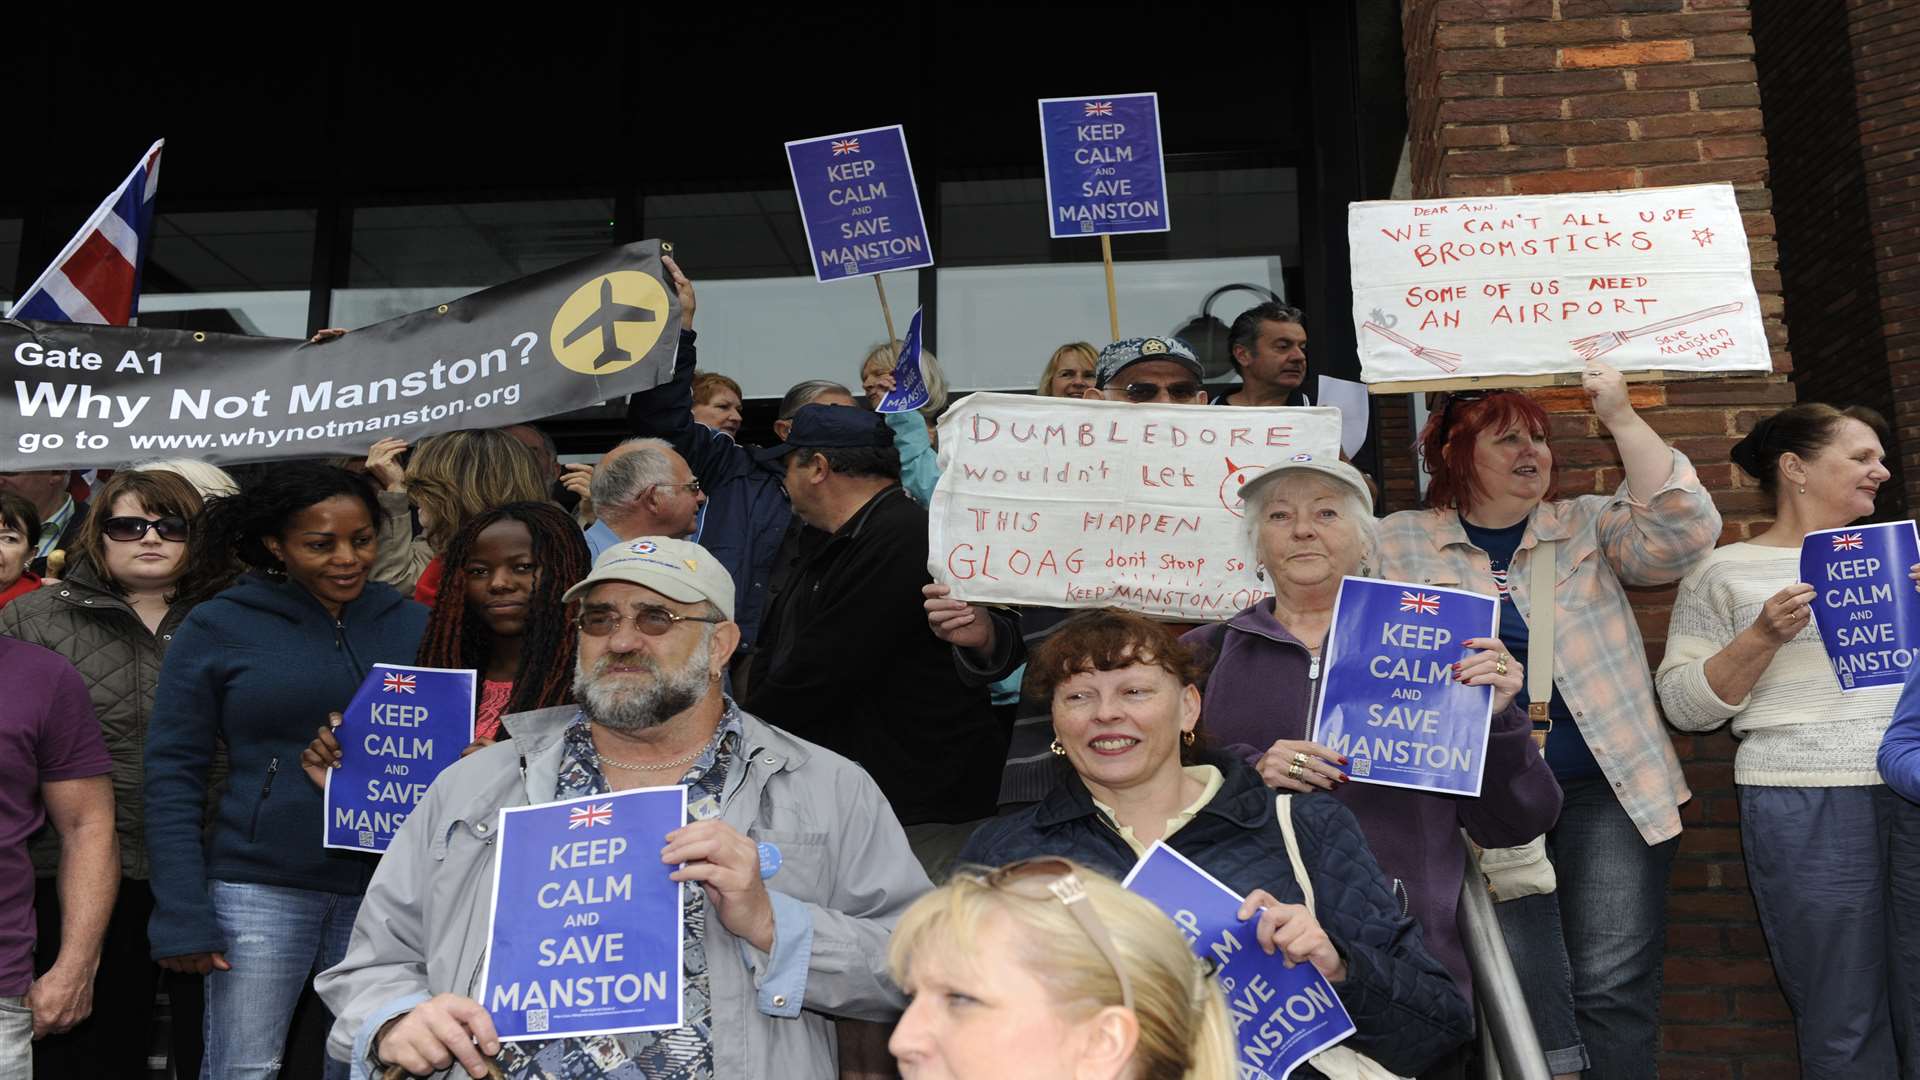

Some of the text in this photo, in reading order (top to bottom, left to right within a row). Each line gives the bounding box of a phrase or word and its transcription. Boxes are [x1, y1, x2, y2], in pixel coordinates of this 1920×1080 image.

[1077, 123, 1125, 142] KEEP
[1074, 145, 1133, 165] CALM
[827, 159, 876, 183] KEEP
[1095, 167, 1116, 176] AND
[829, 182, 887, 206] CALM
[1082, 179, 1132, 197] SAVE
[851, 206, 872, 217] AND
[1059, 199, 1159, 222] MANSTON
[1414, 206, 1449, 216] DEAR
[840, 216, 892, 239] SAVE
[1381, 207, 1697, 242] WE CAN'T ALL USE
[820, 235, 921, 267] MANSTON
[1413, 230, 1655, 268] BROOMSTICKS
[1405, 276, 1649, 308] SOME OF US NEED
[1418, 297, 1659, 331] AN AIRPORT
[14, 341, 163, 376] Gate A1
[14, 331, 539, 428] Why Not Manston?
[18, 383, 521, 453] go to www.whynotmanston.org
[967, 413, 1293, 448] DUMBLEDORE
[967, 507, 1201, 536] THIS HAPPEN
[947, 542, 1086, 580] GLOAG
[1826, 558, 1881, 581] KEEP
[1065, 582, 1104, 601] KEEP
[1825, 583, 1893, 608] CALM
[1850, 610, 1873, 621] AND
[1381, 621, 1451, 651] KEEP
[1837, 623, 1895, 647] SAVE
[1369, 655, 1452, 686] CALM
[1391, 687, 1422, 701] AND
[370, 702, 429, 728] KEEP
[1367, 703, 1440, 734] SAVE
[364, 734, 433, 760] CALM
[1326, 731, 1471, 772] MANSTON
[384, 764, 409, 776] AND
[367, 779, 428, 804] SAVE
[550, 836, 627, 871] KEEP
[537, 873, 632, 909] CALM
[563, 912, 599, 928] AND
[537, 932, 624, 967] SAVE
[491, 971, 667, 1013] MANSTON
[1229, 974, 1276, 1035] AVE
[1239, 981, 1334, 1080] ANSTON
